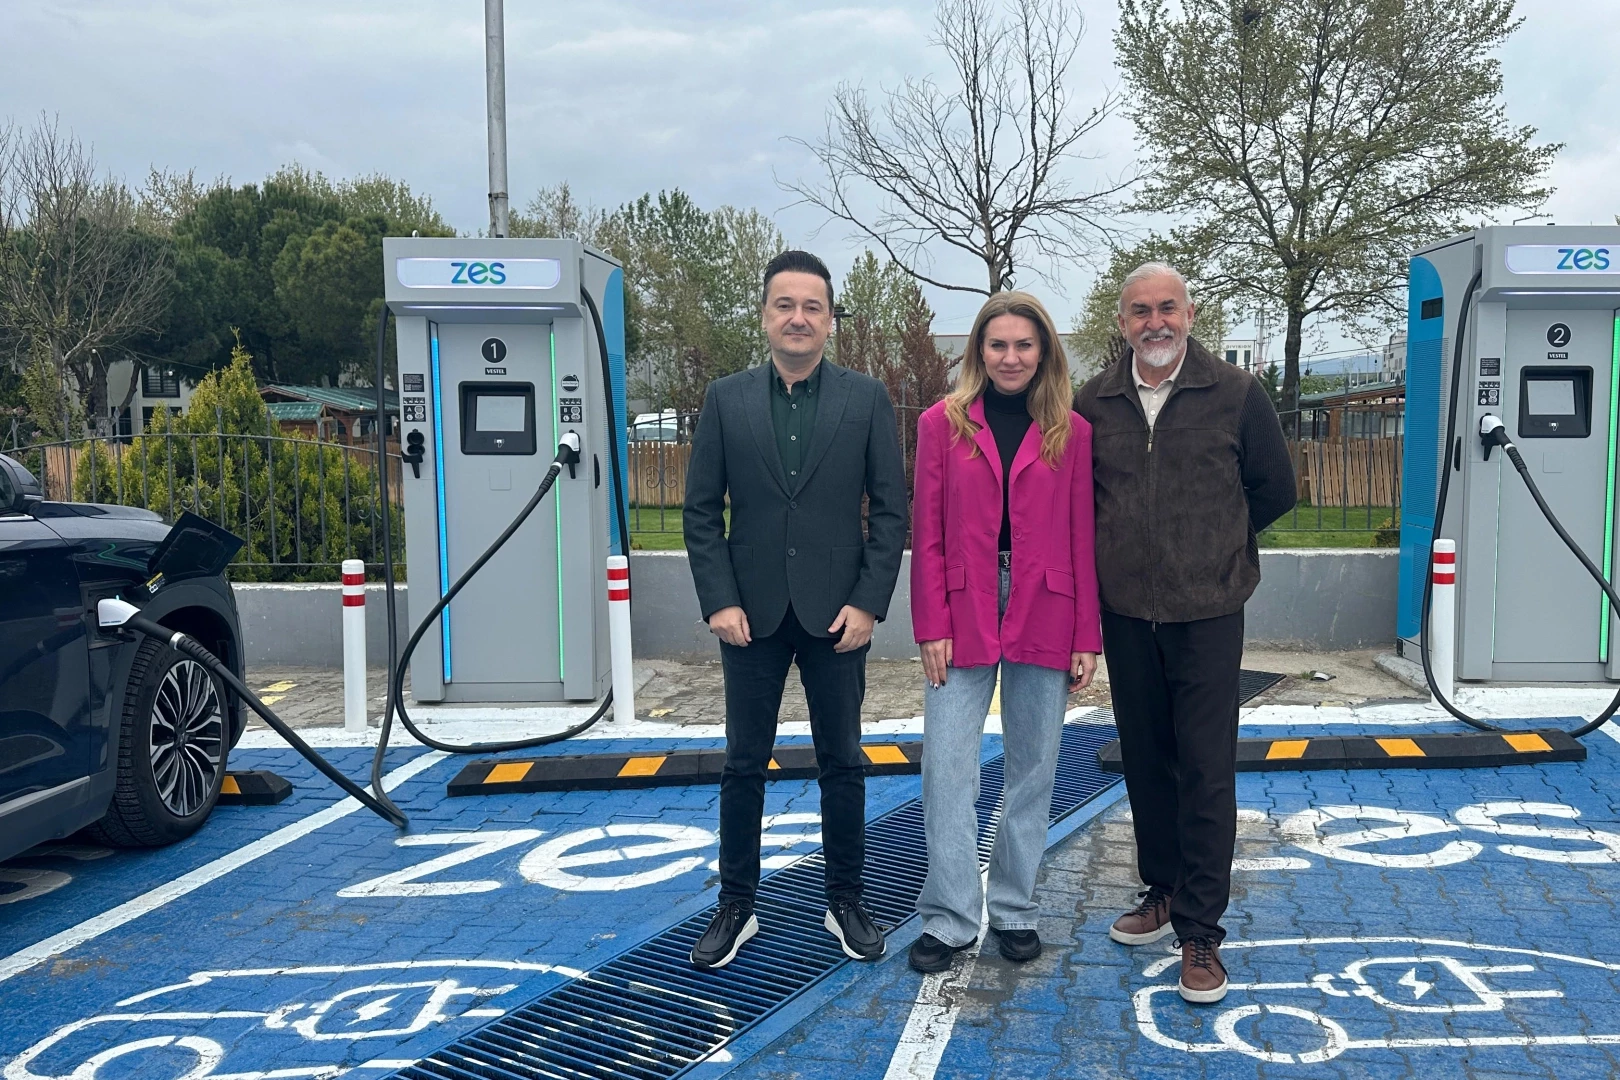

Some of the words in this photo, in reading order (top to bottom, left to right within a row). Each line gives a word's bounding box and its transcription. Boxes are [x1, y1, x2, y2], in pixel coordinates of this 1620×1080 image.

[1556, 248, 1610, 270] zes
[450, 262, 506, 285] zes
[1553, 327, 1565, 344] 2
[490, 342, 497, 359] 1
